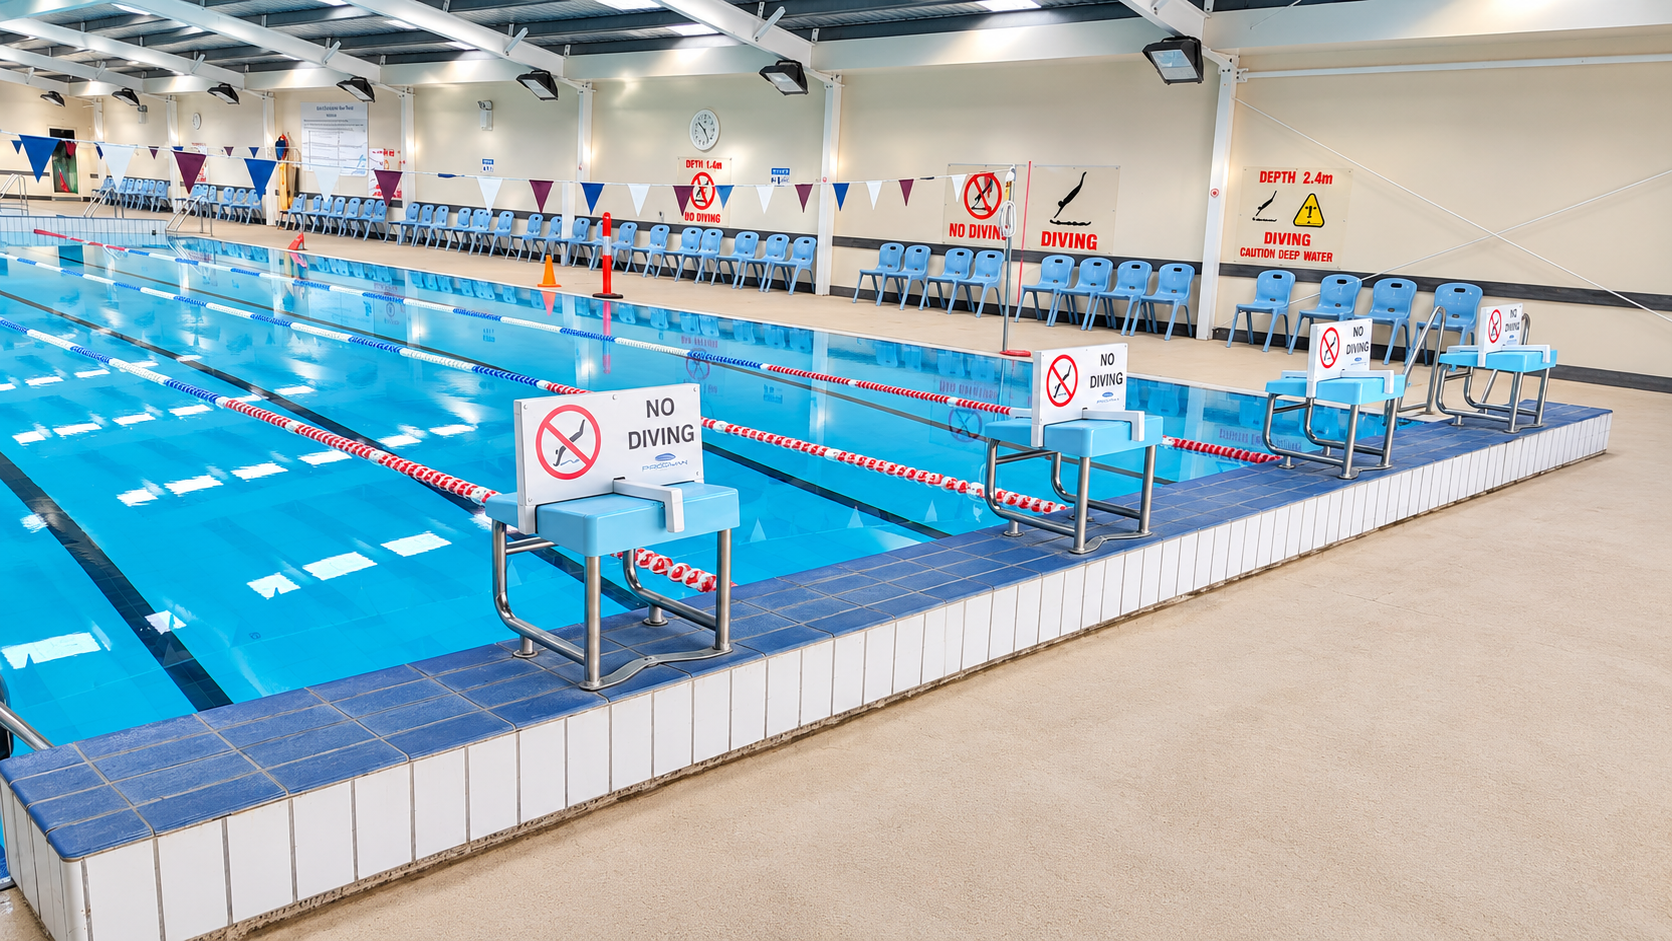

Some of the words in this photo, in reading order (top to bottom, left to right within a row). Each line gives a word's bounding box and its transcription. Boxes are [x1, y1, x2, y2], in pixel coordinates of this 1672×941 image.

[1259, 170, 1297, 184] DEPTH
[1303, 171, 1334, 185] 2.4m
[949, 222, 966, 238] NO
[1041, 231, 1098, 251] DIVING
[1263, 231, 1312, 247] DIVING
[1240, 246, 1276, 259] CAUTION
[1278, 249, 1301, 260] DEEP
[1303, 250, 1334, 263] WATER
[1352, 325, 1364, 338] NO
[1346, 341, 1369, 355] DIVING
[1100, 352, 1115, 367] NO
[1090, 371, 1124, 389] DIVING
[646, 397, 675, 418] NO
[628, 424, 695, 450] DIVING
